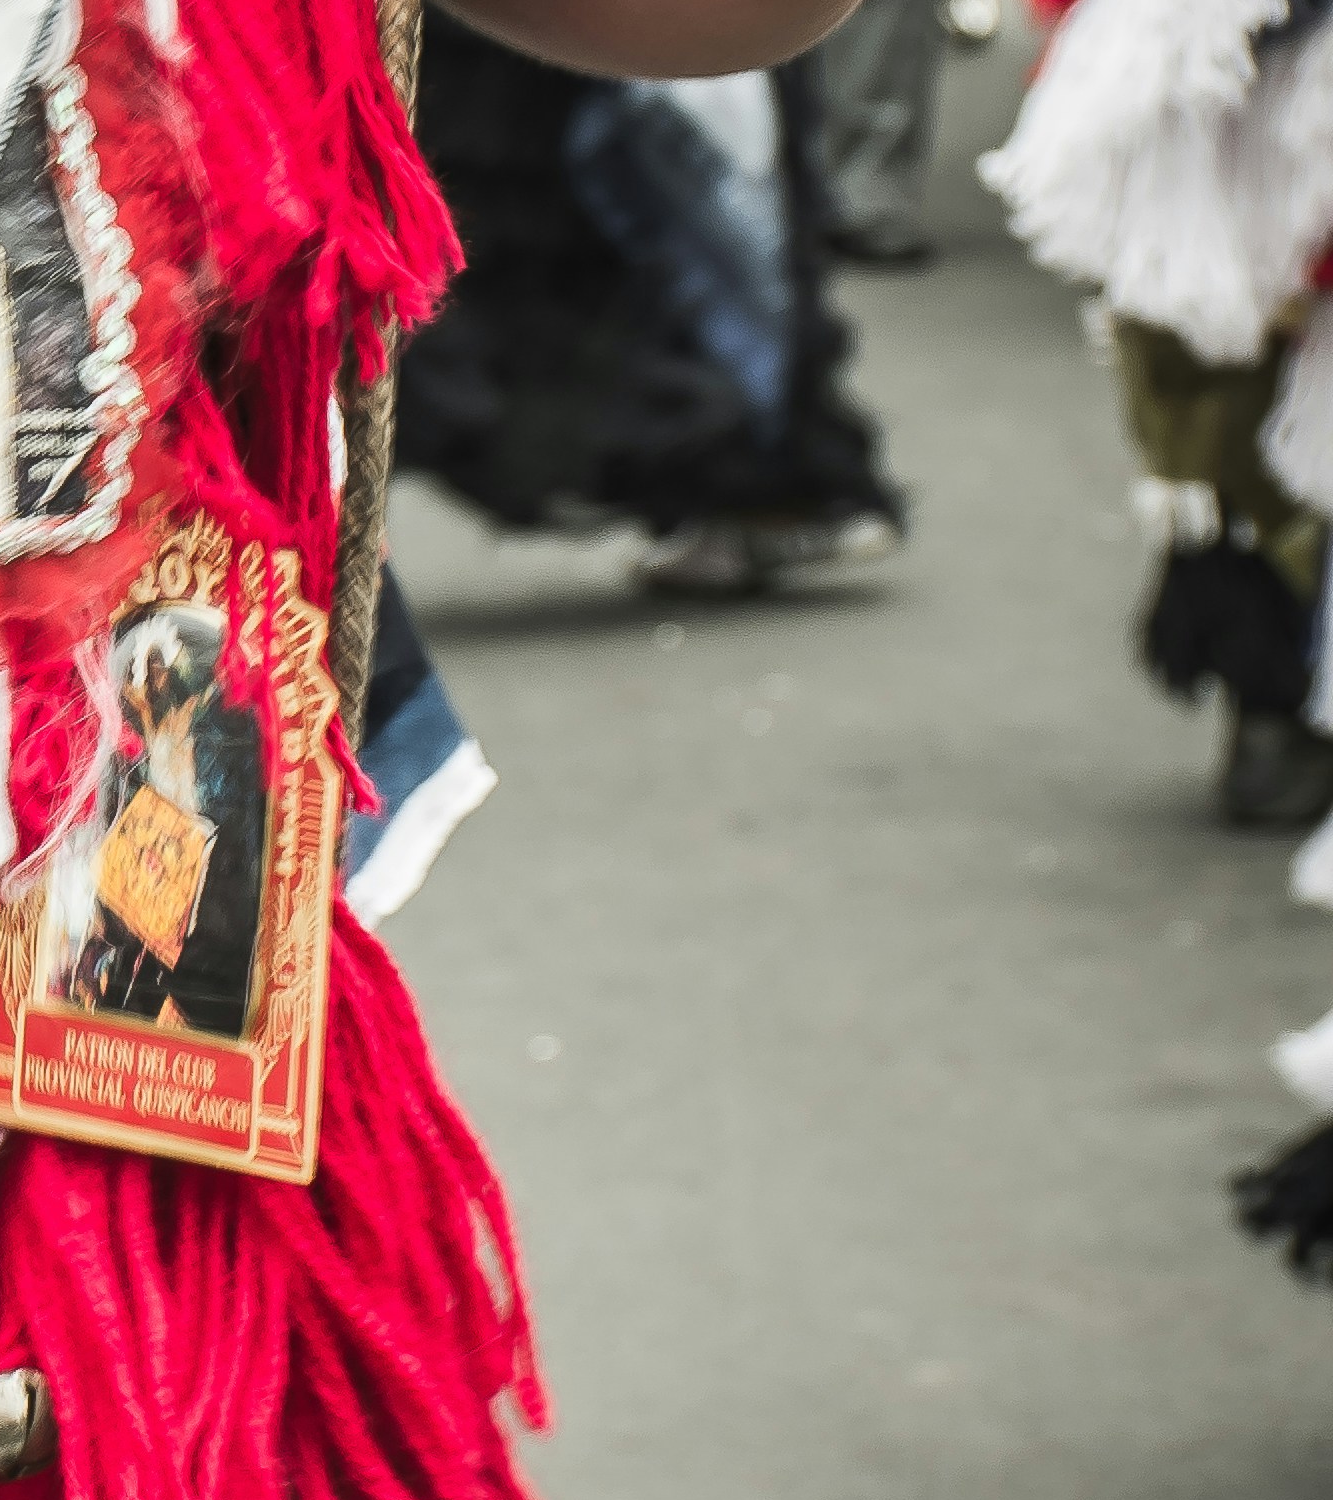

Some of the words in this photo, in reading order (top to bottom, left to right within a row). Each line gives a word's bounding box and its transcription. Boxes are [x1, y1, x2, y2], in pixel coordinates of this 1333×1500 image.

[24, 1052, 126, 1110] PROVINCIAL
[64, 1027, 135, 1075] PATRON
[136, 1044, 171, 1081] DEL
[171, 1051, 217, 1091] CLUB
